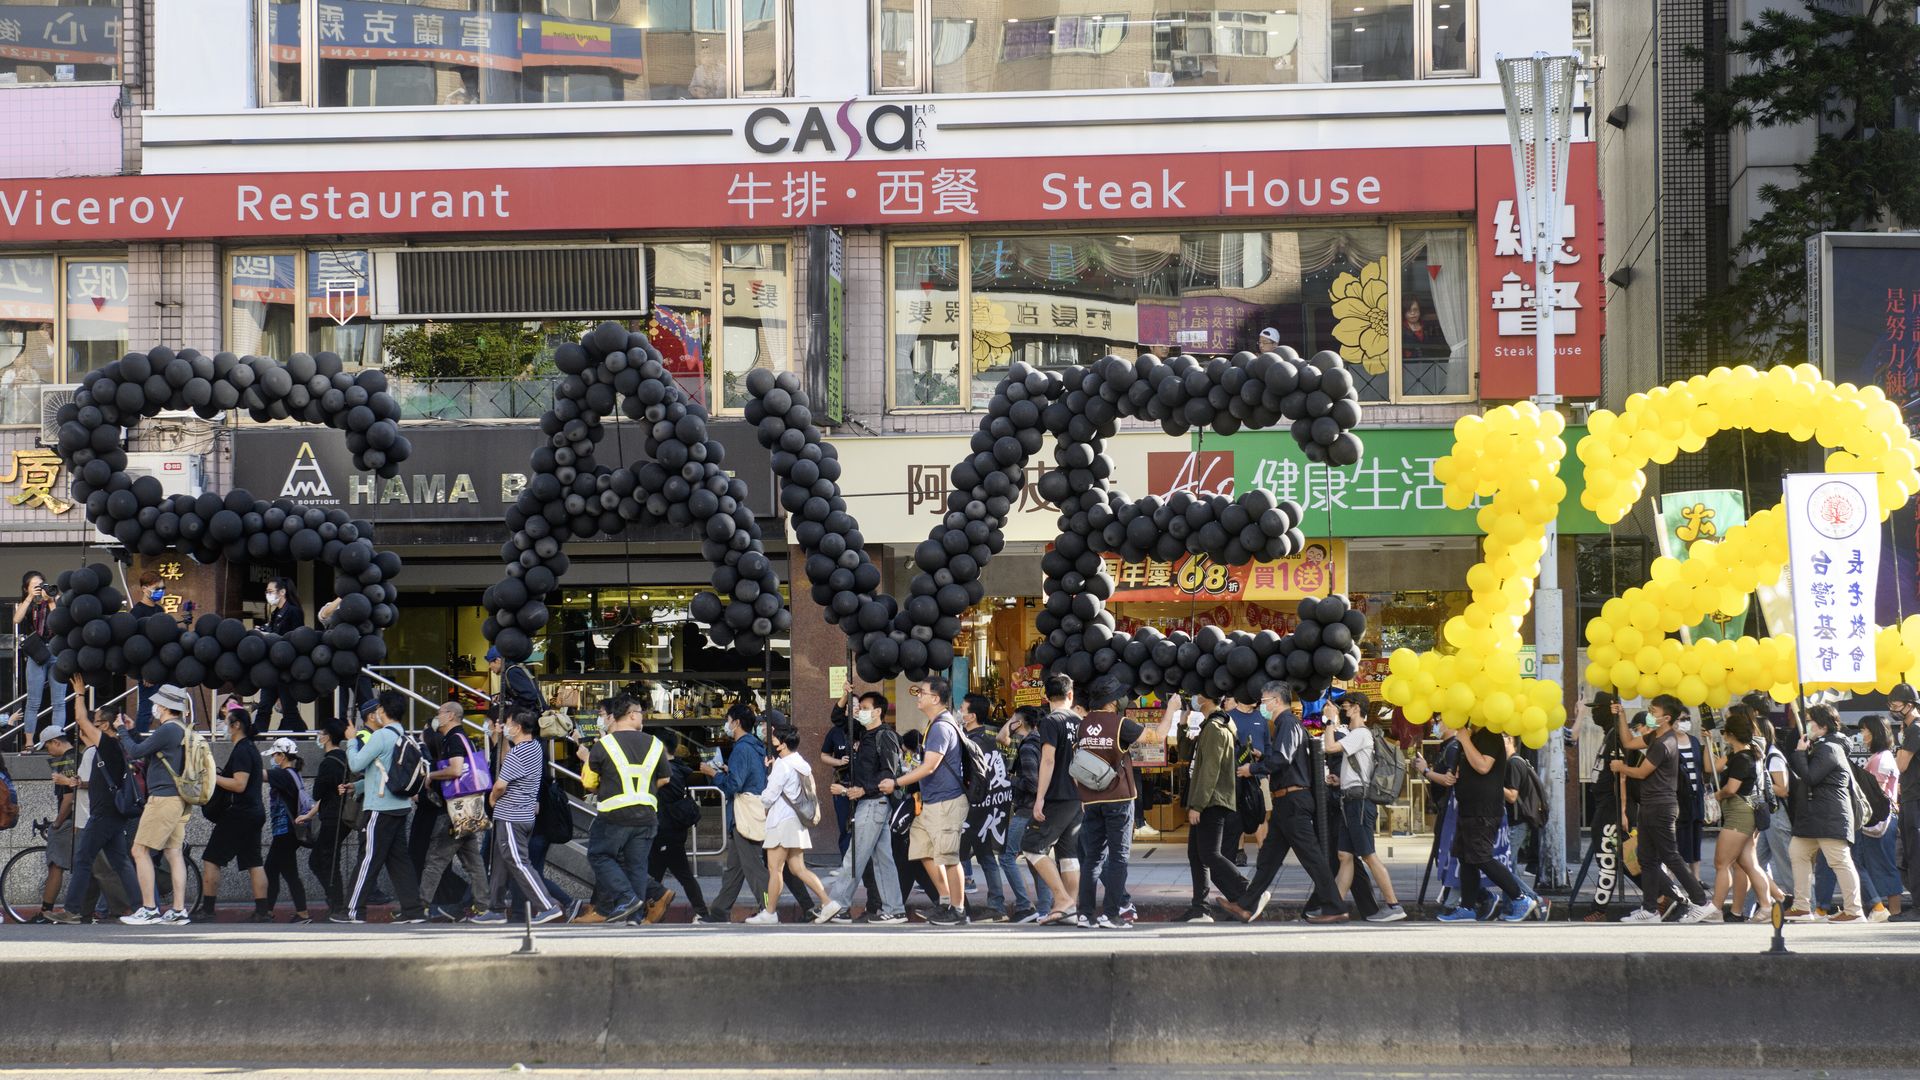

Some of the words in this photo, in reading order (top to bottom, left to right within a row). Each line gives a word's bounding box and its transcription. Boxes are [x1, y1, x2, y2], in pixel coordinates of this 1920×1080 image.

[914, 104, 927, 152] HAIR
[0, 189, 184, 230] Viceroy
[236, 183, 511, 222] Restaurant
[1042, 169, 1187, 211] Steak
[1224, 169, 1382, 208] House
[1494, 346, 1534, 357] Steak
[1554, 346, 1582, 355] ouse
[349, 473, 479, 505] HAMA
[1251, 456, 1498, 511] 健康生活
[159, 562, 185, 614] 漢宮
[1178, 551, 1229, 594] 68
[992, 790, 1013, 805] KONG
[1595, 823, 1617, 906] adidas
